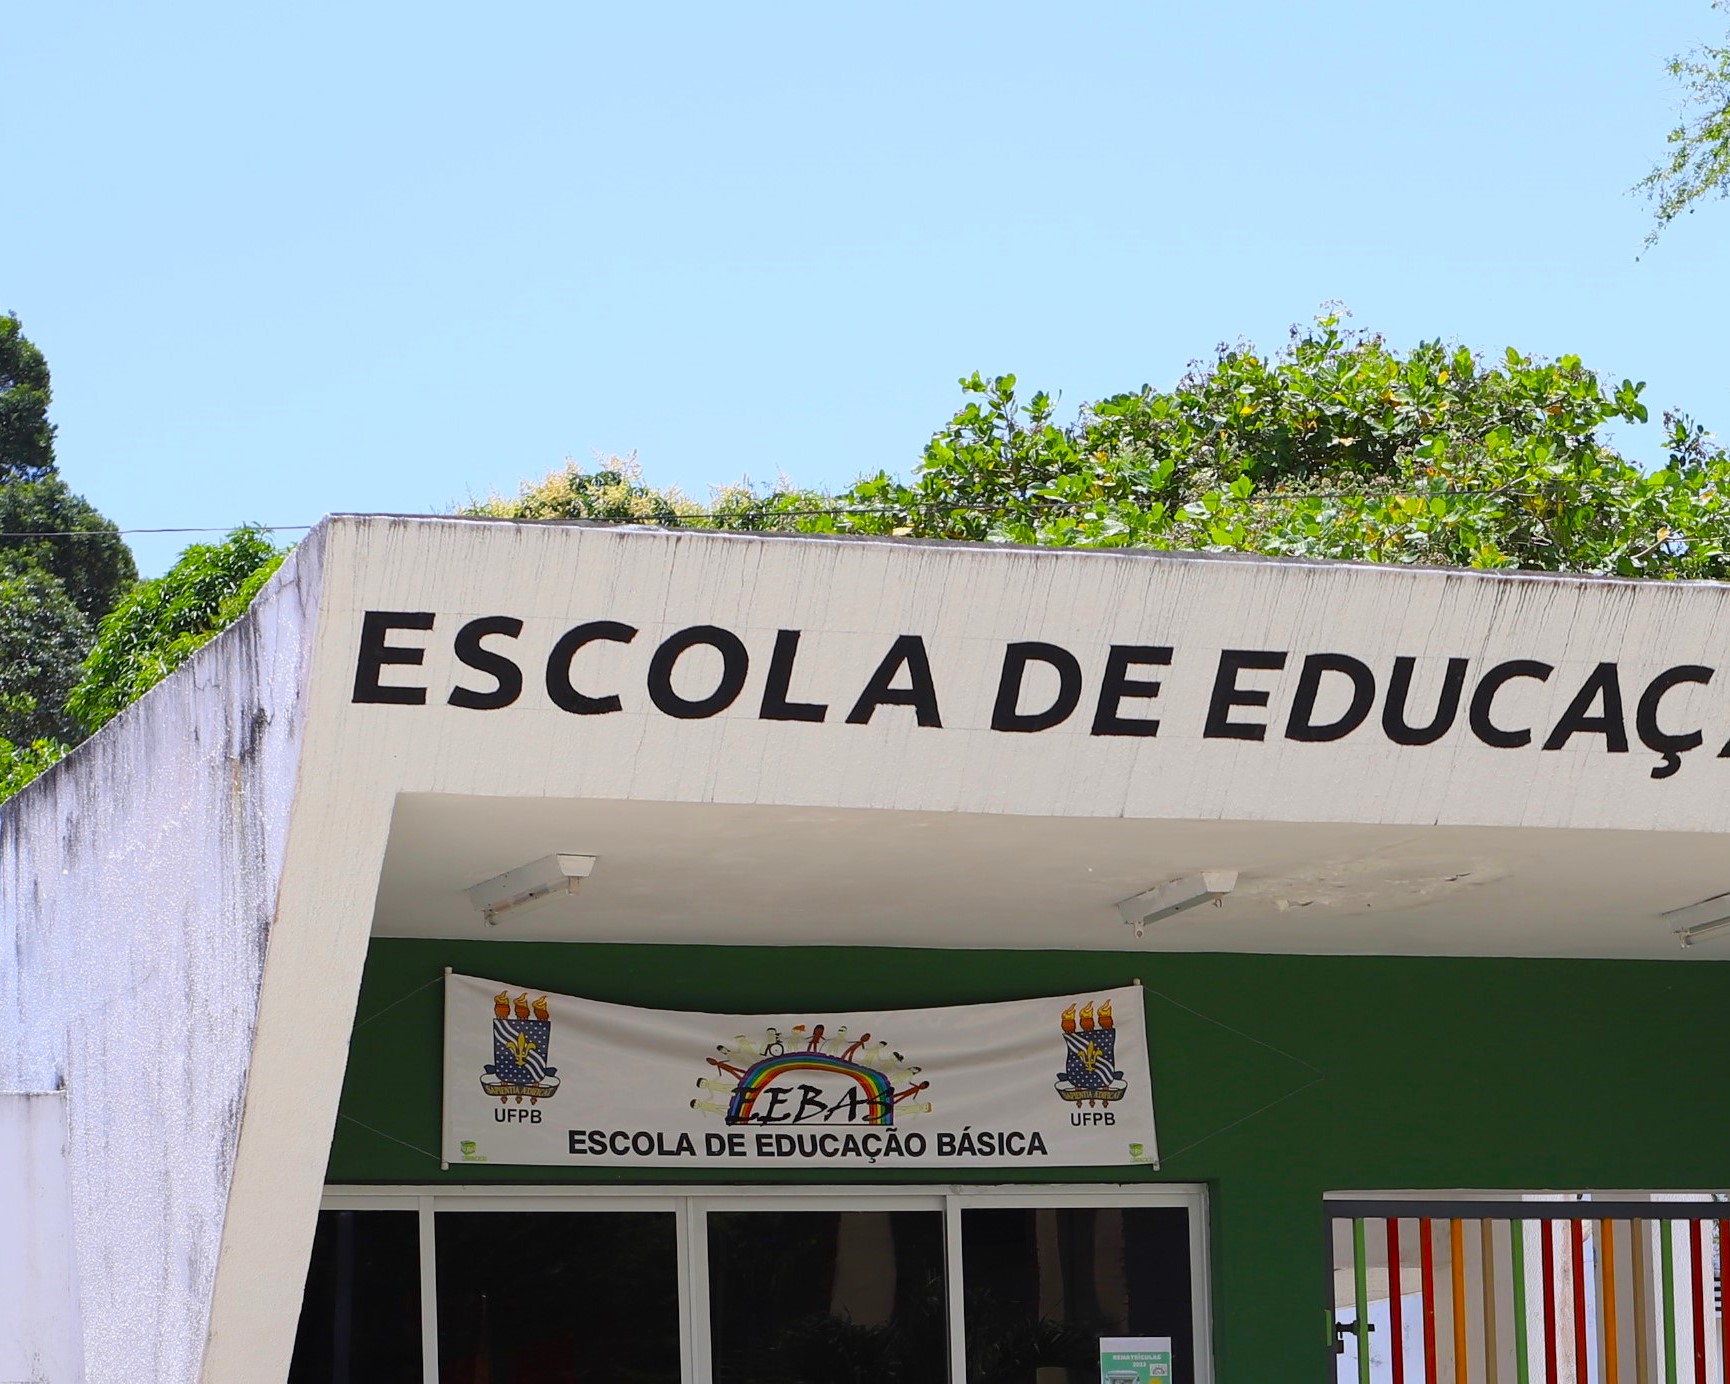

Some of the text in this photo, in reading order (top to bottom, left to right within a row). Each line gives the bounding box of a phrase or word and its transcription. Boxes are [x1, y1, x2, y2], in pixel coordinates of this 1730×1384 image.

[351, 610, 944, 729] ESCOLA
[990, 641, 1175, 738] DE
[494, 1108, 542, 1124] UFPB
[725, 1084, 895, 1126] EEBAS
[1070, 1112, 1116, 1127] UFPB
[568, 1125, 1048, 1164] ESCOLA DE EDUCAÇÃO BÁSICA
